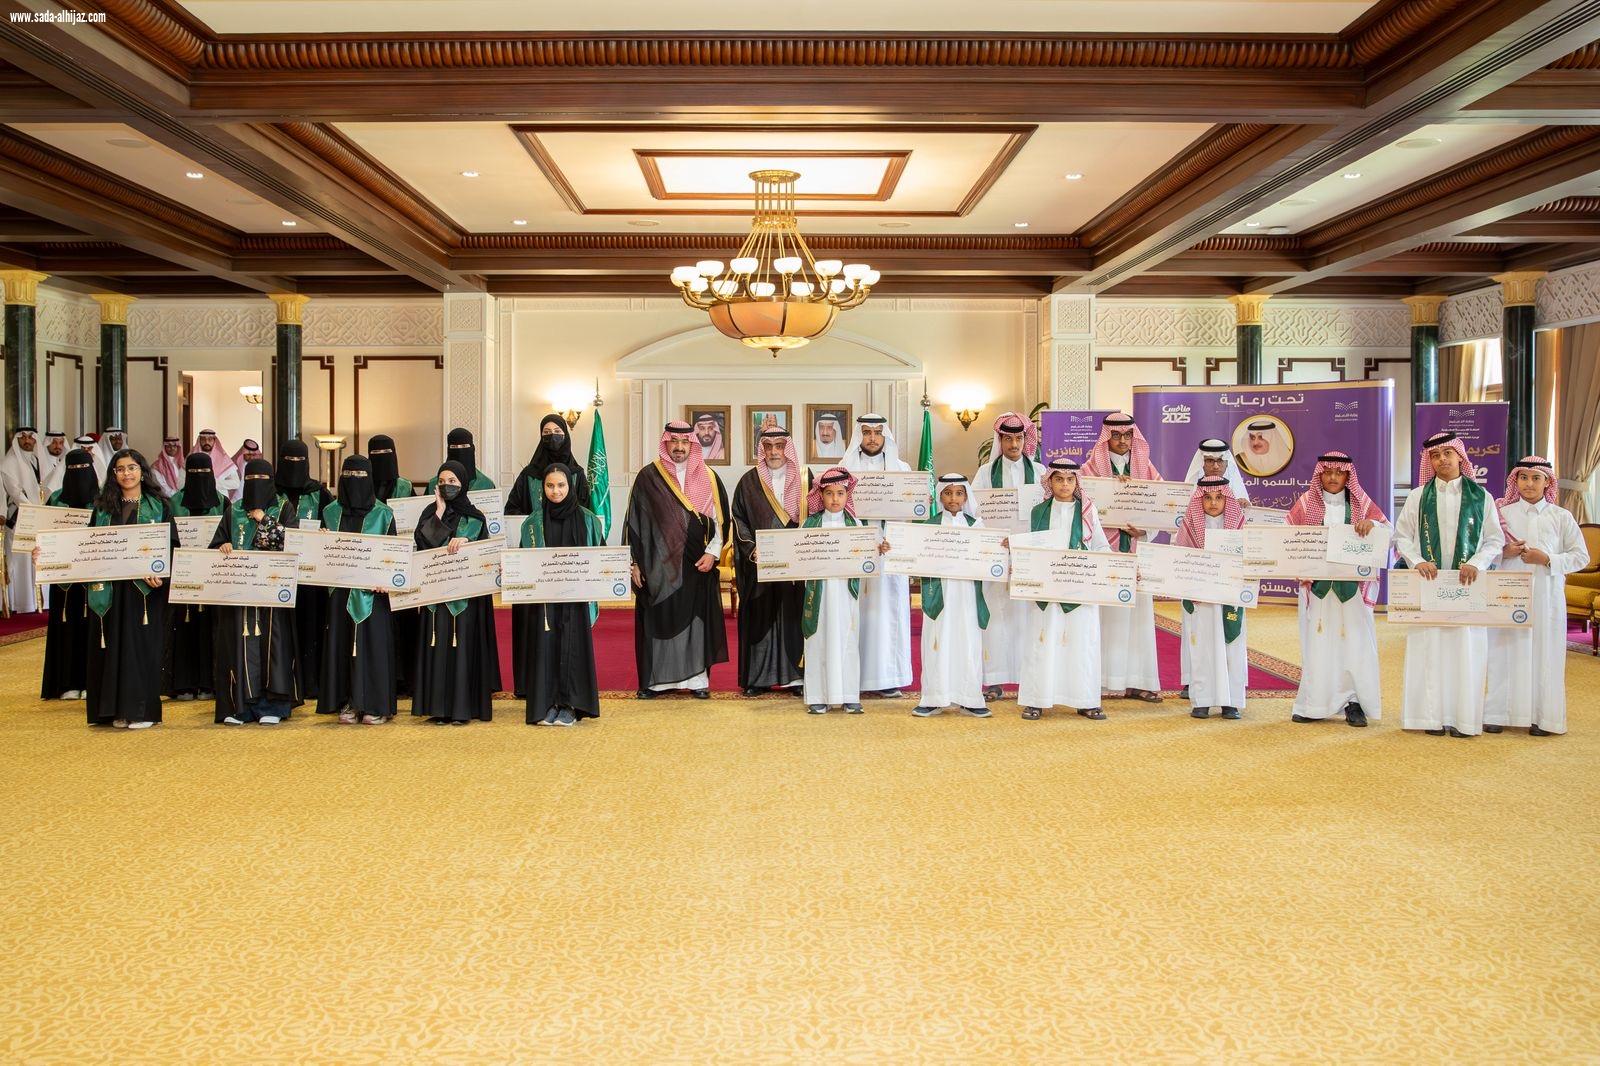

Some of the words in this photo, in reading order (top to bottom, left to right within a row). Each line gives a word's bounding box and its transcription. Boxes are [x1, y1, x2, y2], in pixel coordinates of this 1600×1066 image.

[1220, 394, 1265, 407] رعاية
[1268, 394, 1304, 404] تحت
[1162, 413, 1191, 424] 2025
[1046, 446, 1082, 458] الفائزين
[1467, 444, 1500, 456] تكريم
[1262, 478, 1295, 487] السمو
[1261, 582, 1292, 593] مستو
